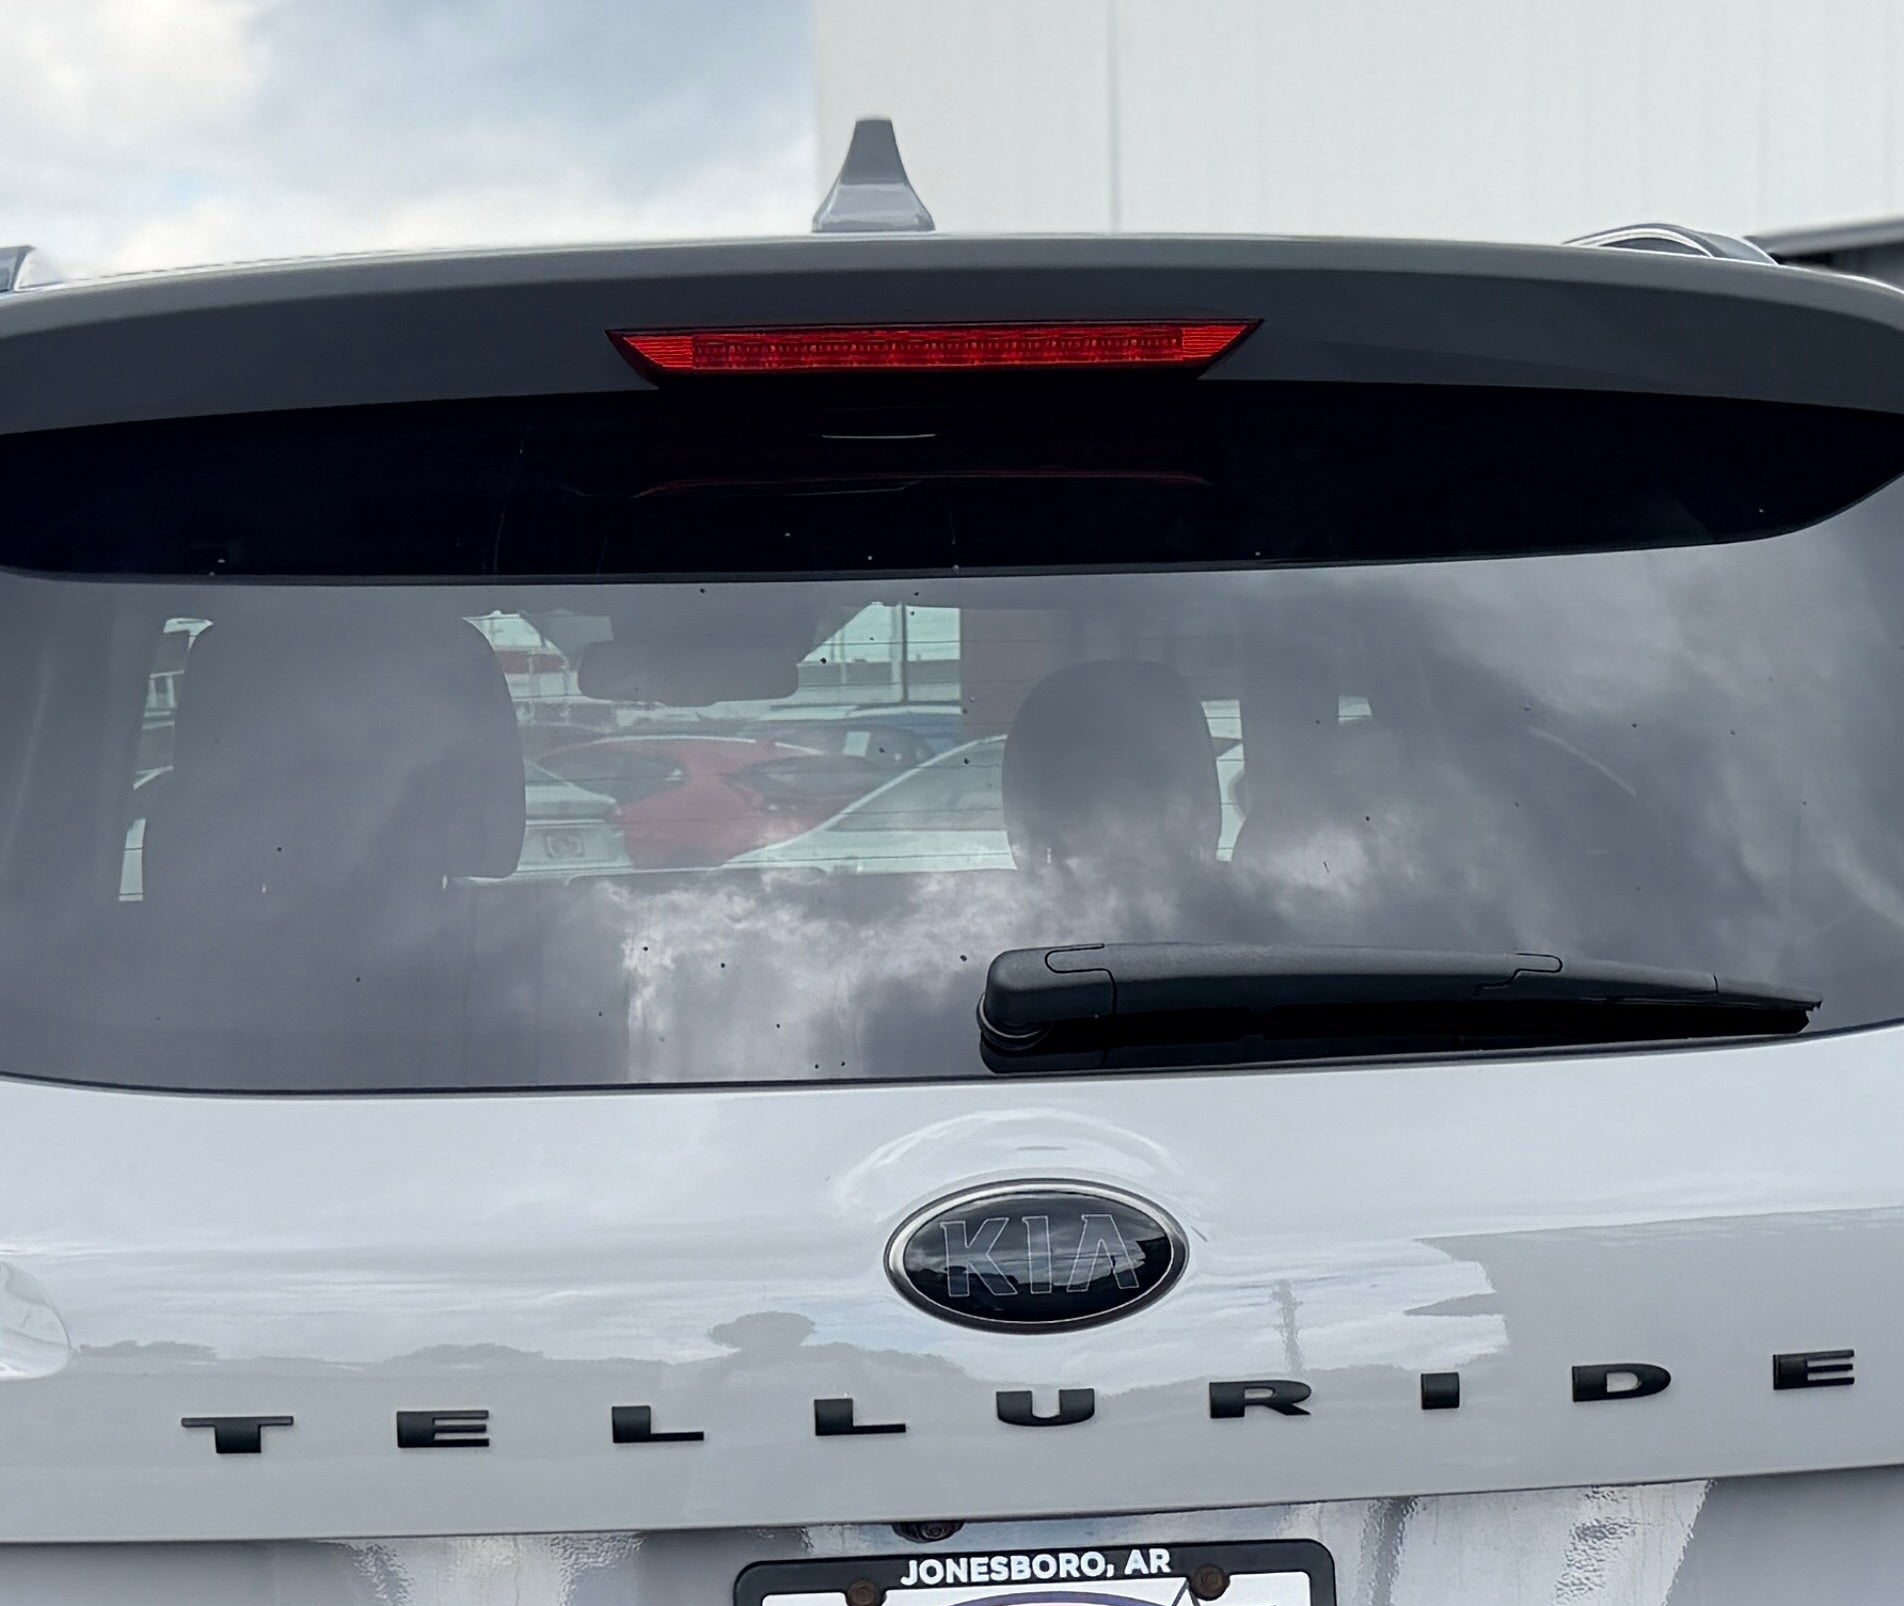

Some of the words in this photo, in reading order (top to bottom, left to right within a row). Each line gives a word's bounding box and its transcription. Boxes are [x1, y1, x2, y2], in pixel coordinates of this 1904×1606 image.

[939, 1214, 1140, 1298] KIA
[181, 1348, 1855, 1454] TELLURIDE
[900, 1551, 1115, 1587] JONESBORO,
[1124, 1548, 1172, 1575] AR
